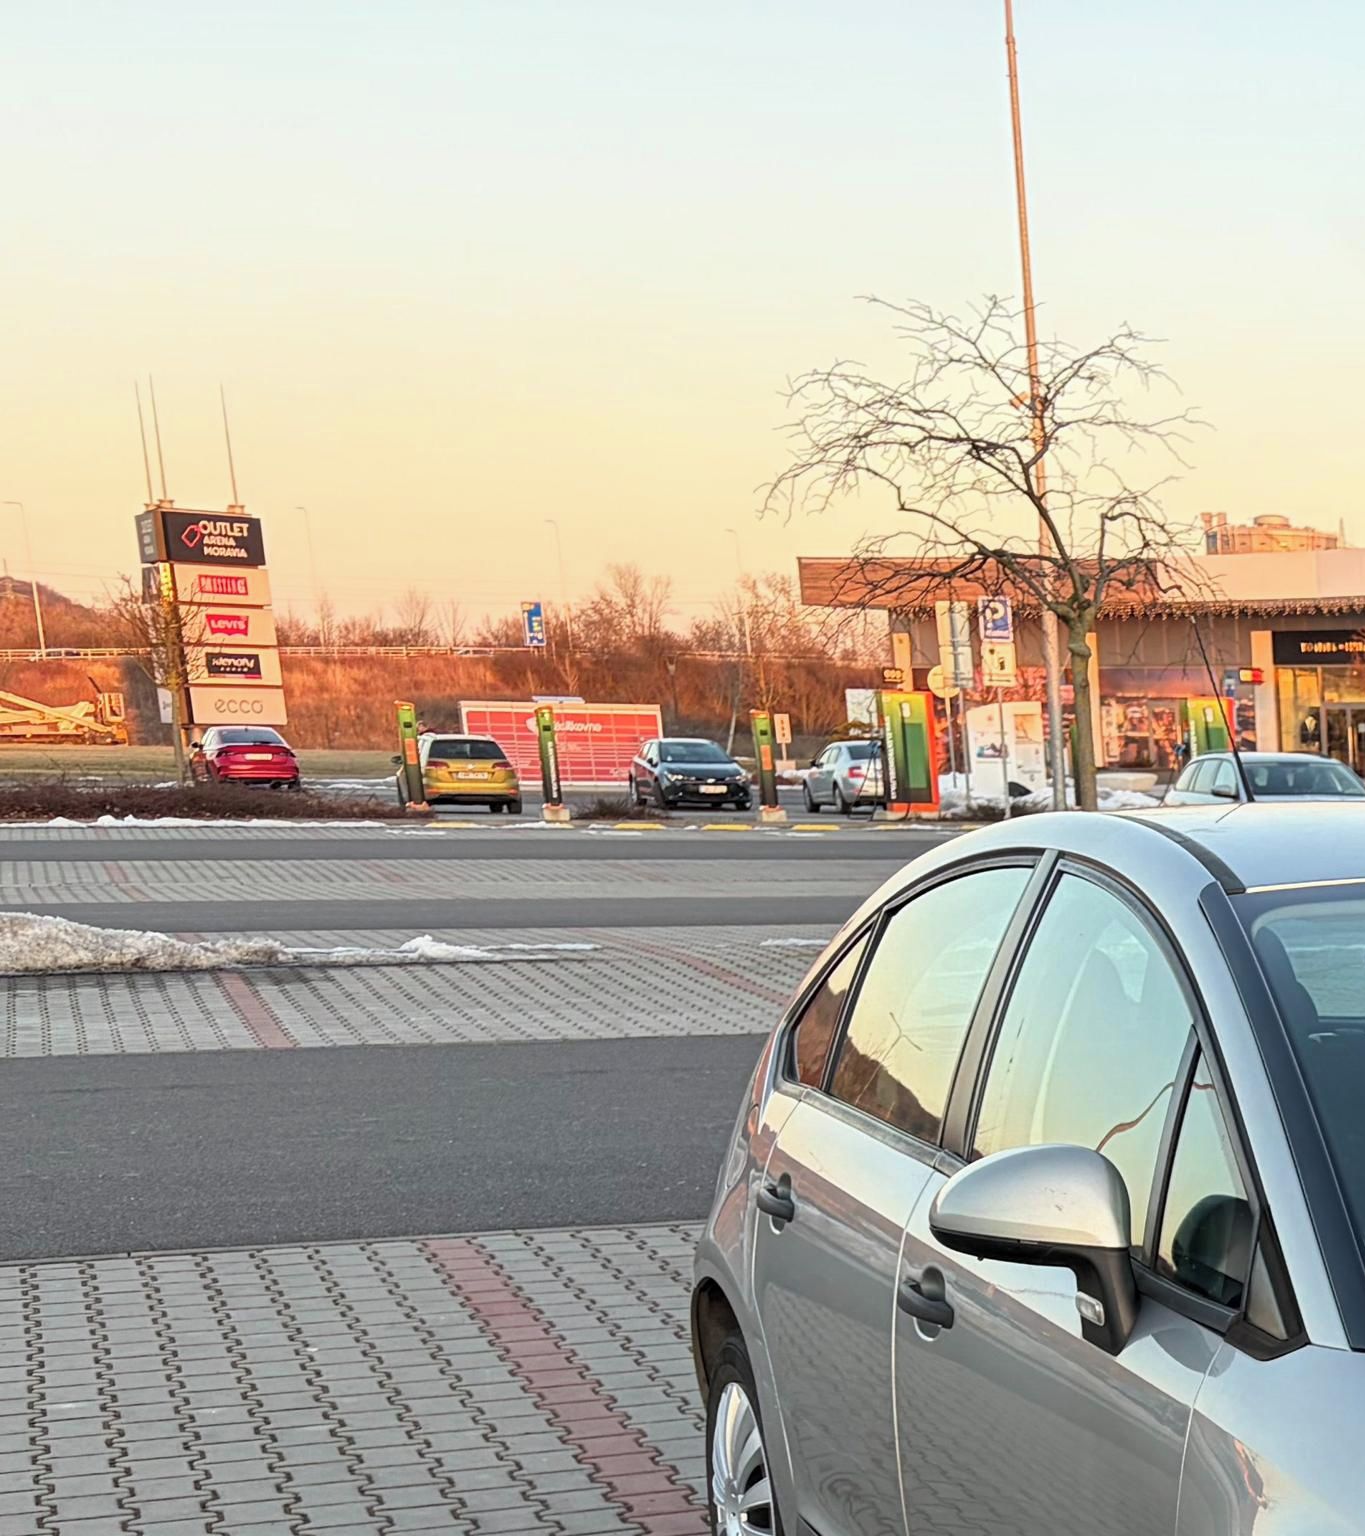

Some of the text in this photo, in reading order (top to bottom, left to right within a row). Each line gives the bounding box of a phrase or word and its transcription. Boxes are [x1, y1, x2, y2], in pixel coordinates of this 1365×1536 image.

[199, 520, 249, 537] OUTLET
[203, 536, 236, 546] ARENA
[203, 546, 248, 558] MORAVIA
[214, 699, 264, 714] ecco
